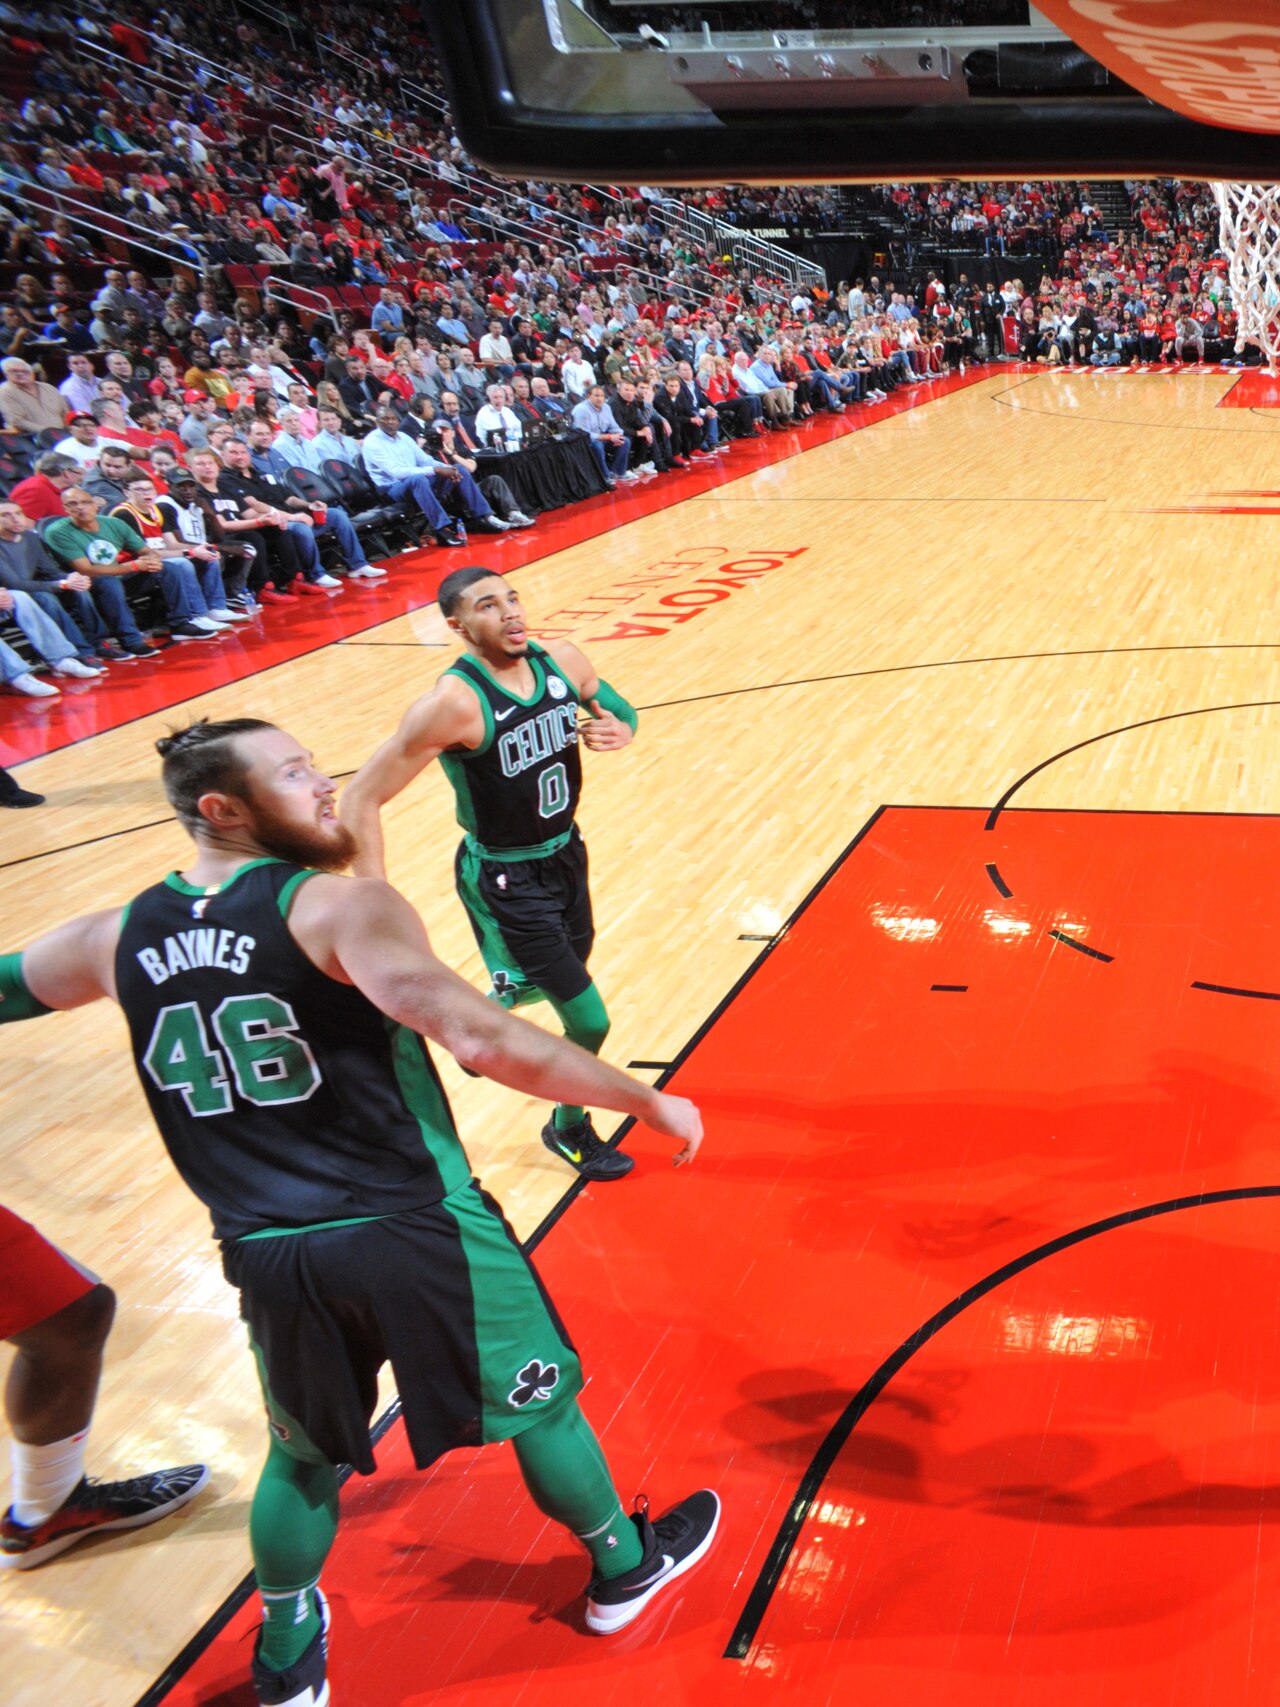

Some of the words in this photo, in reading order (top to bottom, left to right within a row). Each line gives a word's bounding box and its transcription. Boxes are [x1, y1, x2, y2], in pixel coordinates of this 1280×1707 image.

[753, 228, 790, 239] TUNNEL
[583, 546, 811, 643] TOYOTA
[498, 701, 578, 778] CELTICS
[537, 762, 570, 819] 0
[135, 928, 257, 986] BAYNES
[142, 992, 323, 1118] 46
